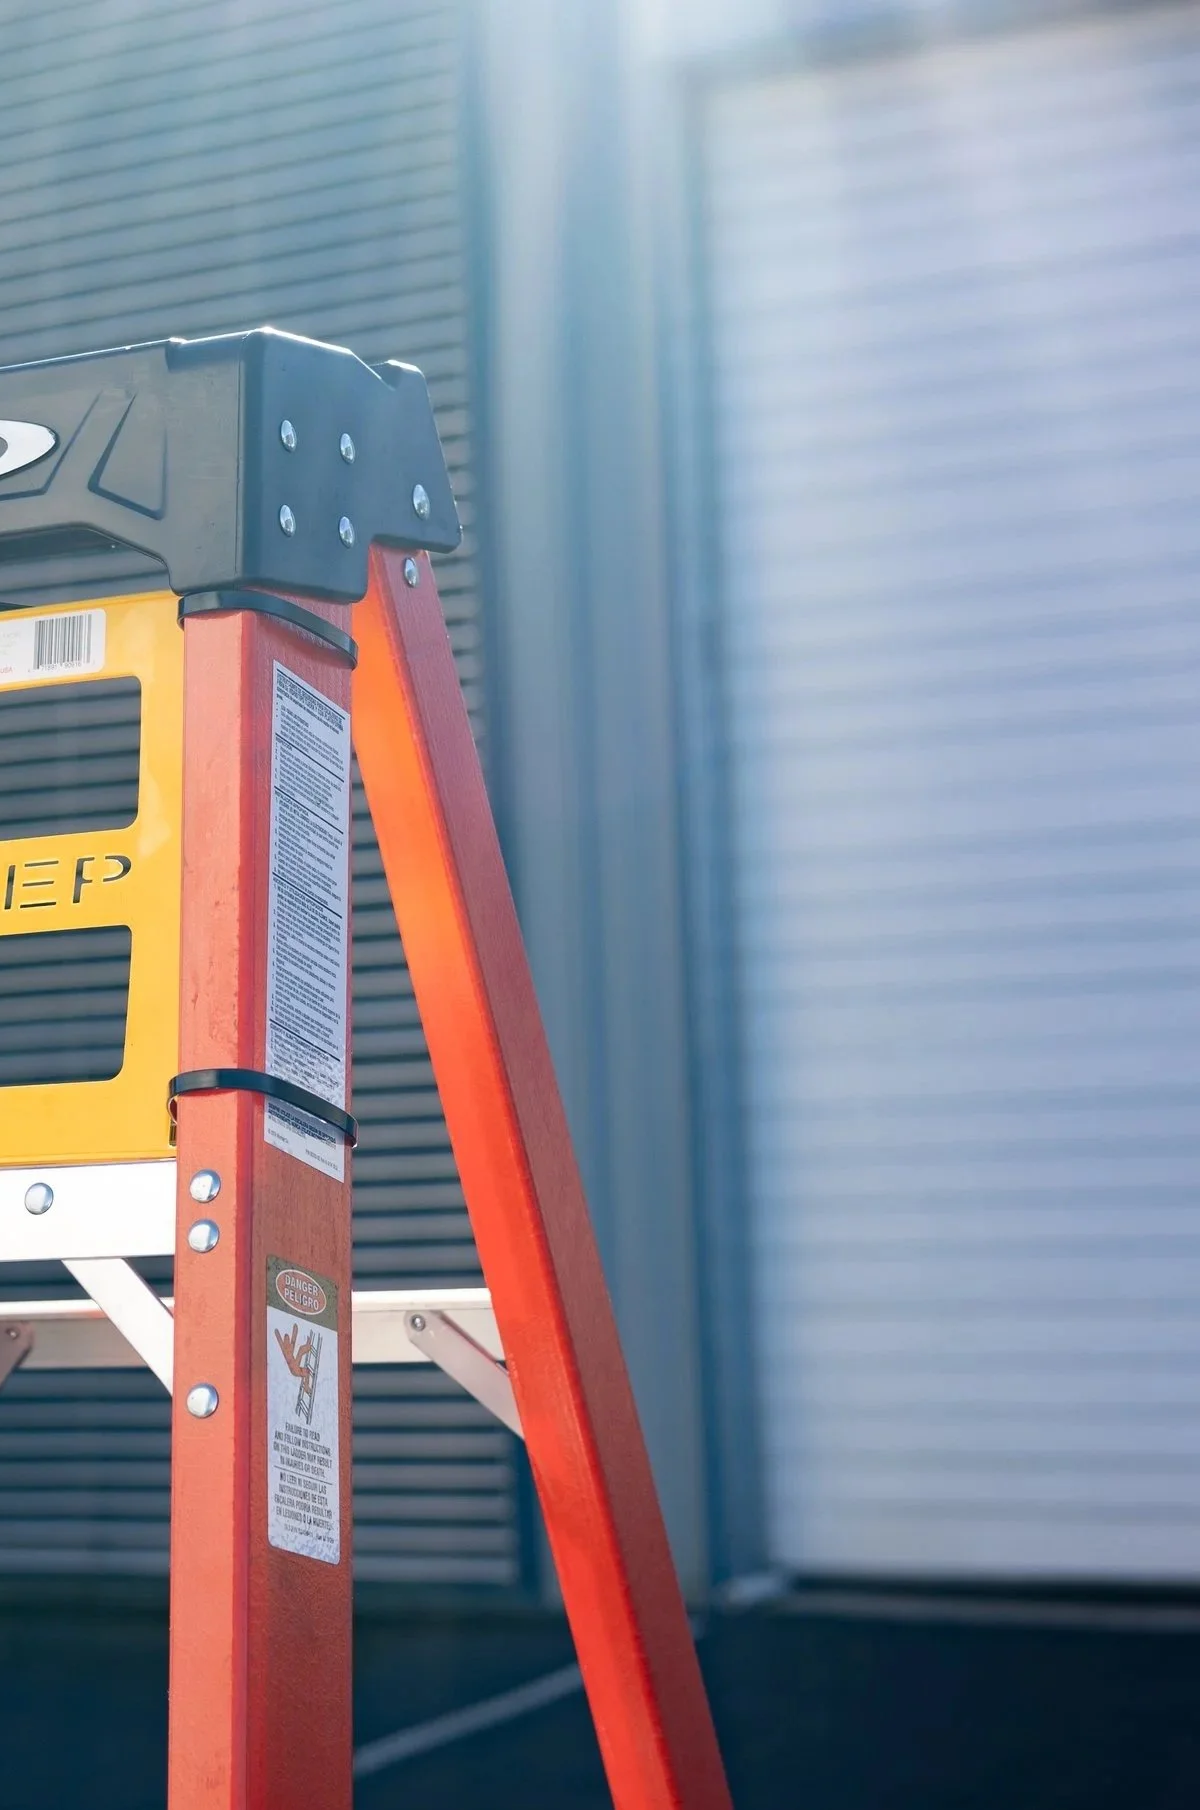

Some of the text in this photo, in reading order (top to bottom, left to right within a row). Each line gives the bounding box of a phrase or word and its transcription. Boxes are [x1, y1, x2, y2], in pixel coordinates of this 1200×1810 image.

[0, 665, 13, 674] USA
[285, 1273, 319, 1297] DANGER
[284, 1287, 319, 1311] PELIGRO
